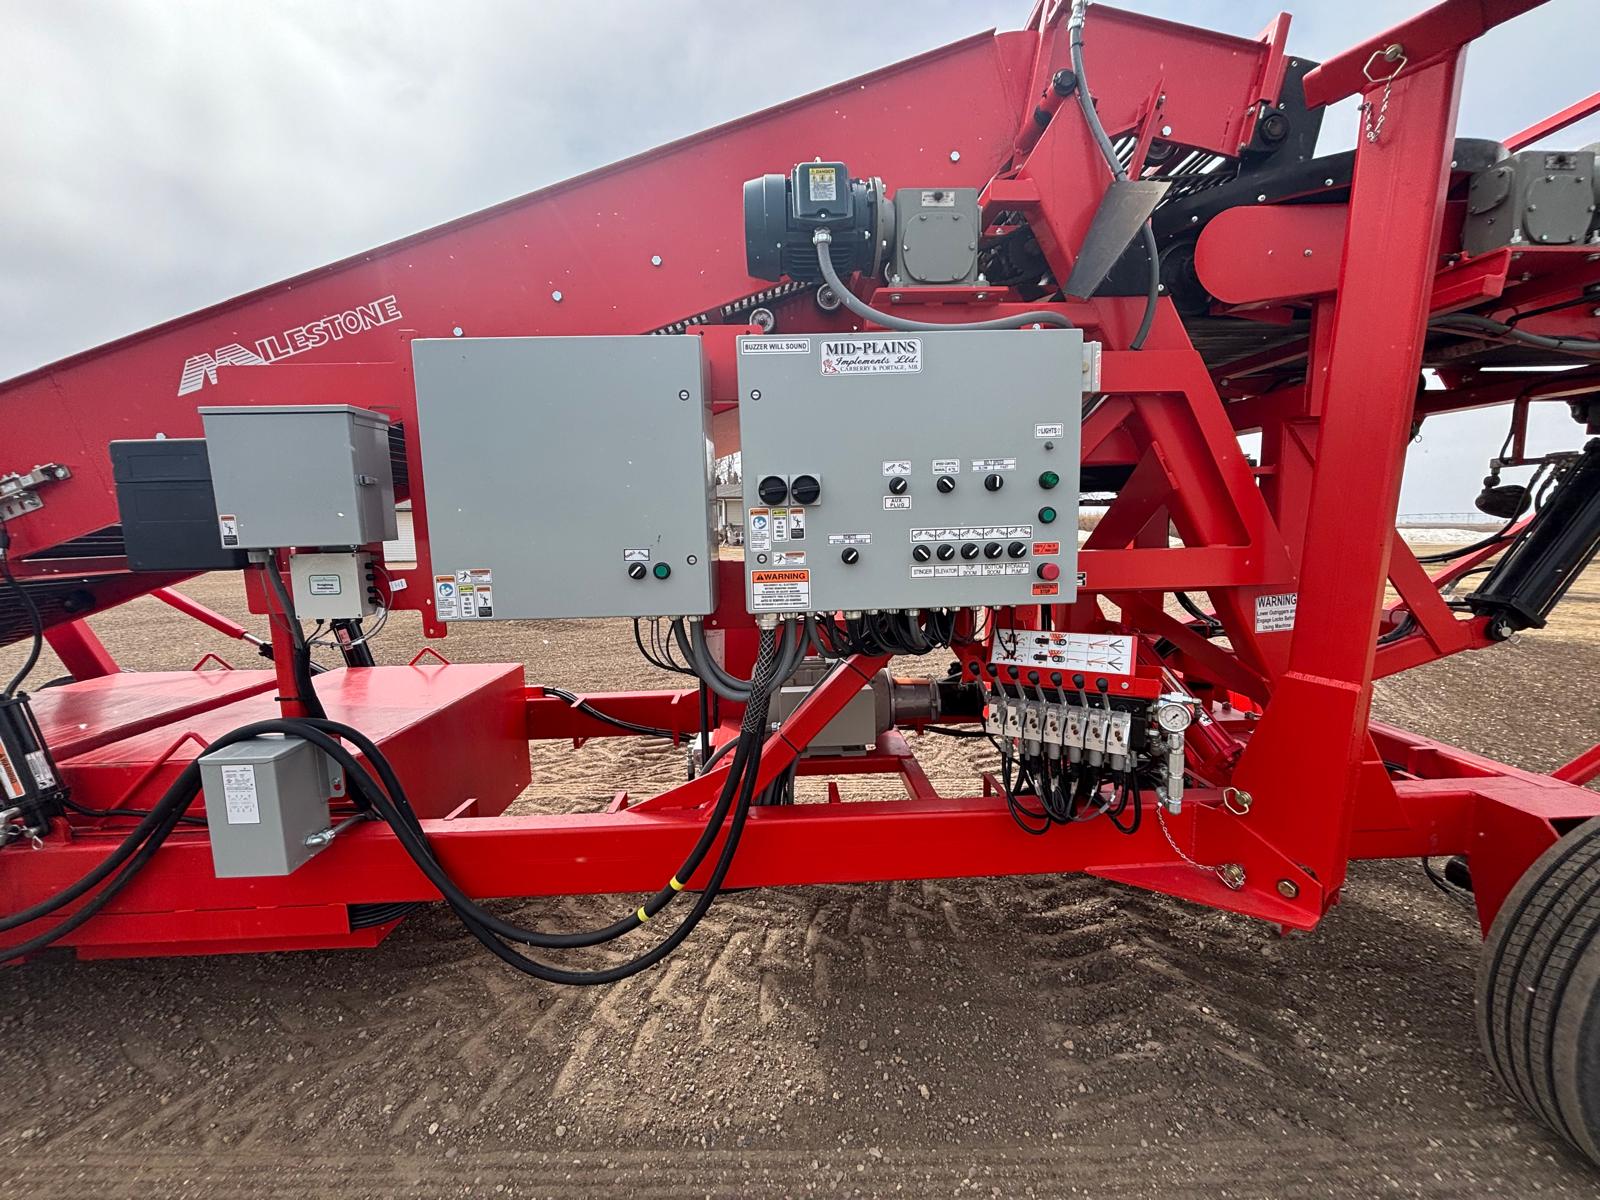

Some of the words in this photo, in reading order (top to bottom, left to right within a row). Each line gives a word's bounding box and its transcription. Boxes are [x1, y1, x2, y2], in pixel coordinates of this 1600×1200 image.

[178, 295, 402, 397] MILESTONE
[826, 341, 916, 355] MID-PLAINS
[834, 356, 890, 366] Implements
[894, 355, 918, 364] Ltd.
[1258, 594, 1297, 607] WARNING
